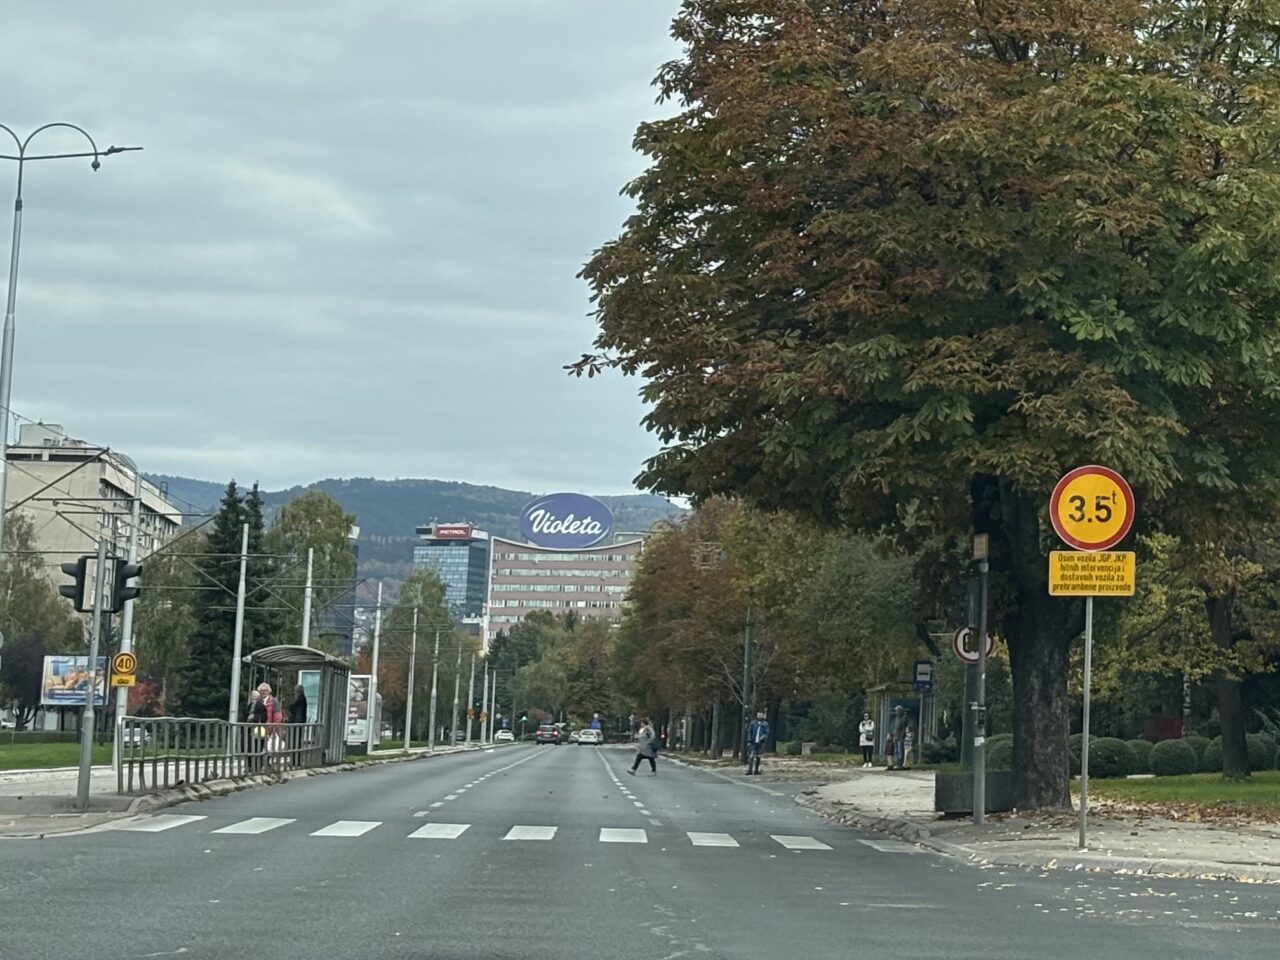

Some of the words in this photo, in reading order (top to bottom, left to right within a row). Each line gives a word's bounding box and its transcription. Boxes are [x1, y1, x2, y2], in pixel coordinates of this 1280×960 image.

[529, 509, 604, 535] Violeta
[1058, 554, 1075, 562] Osim
[1077, 554, 1096, 562] vozila
[1060, 563, 1079, 572] hitnih
[1081, 564, 1121, 574] intervencija
[1060, 573, 1093, 581] dostavnih
[1095, 573, 1114, 581] vozila
[1052, 583, 1096, 592] prehrambene
[1098, 583, 1131, 592] proizvode
[117, 658, 131, 669] 40
